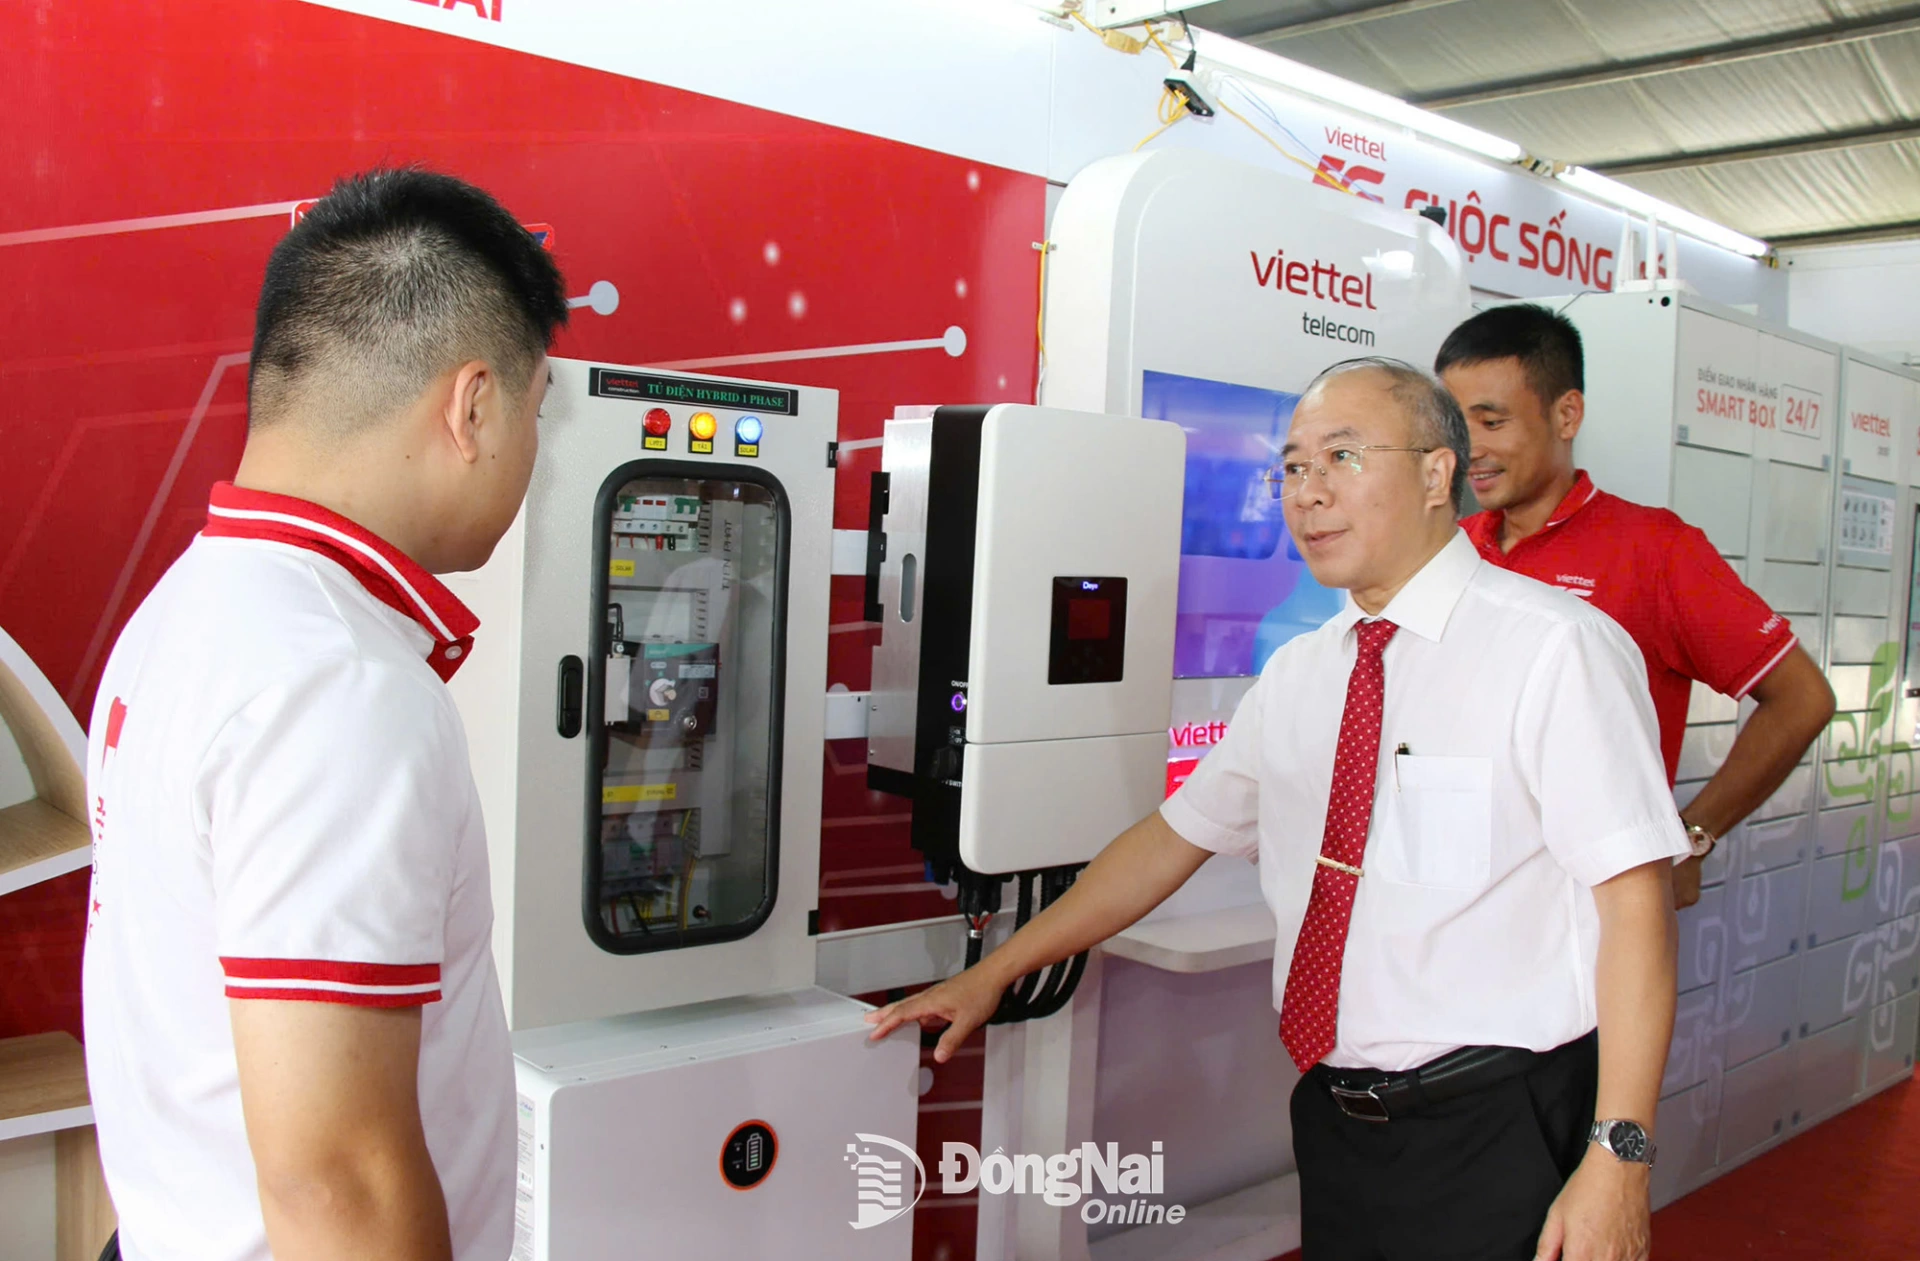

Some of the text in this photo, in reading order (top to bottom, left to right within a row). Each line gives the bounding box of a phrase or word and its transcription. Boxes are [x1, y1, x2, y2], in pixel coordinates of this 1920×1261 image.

[1324, 125, 1387, 162] viettel
[1518, 208, 1613, 291] SỐNG
[1250, 249, 1377, 310] viettel
[1302, 311, 1376, 348] telecom
[606, 377, 639, 389] viettel
[648, 381, 785, 408] TỦ ĐIỆN HYBRID 1 PHASE
[1696, 388, 1776, 429] SMART BOX
[1785, 396, 1819, 431] 24/7
[1851, 411, 1892, 438] viettel
[1555, 573, 1596, 588] viettel
